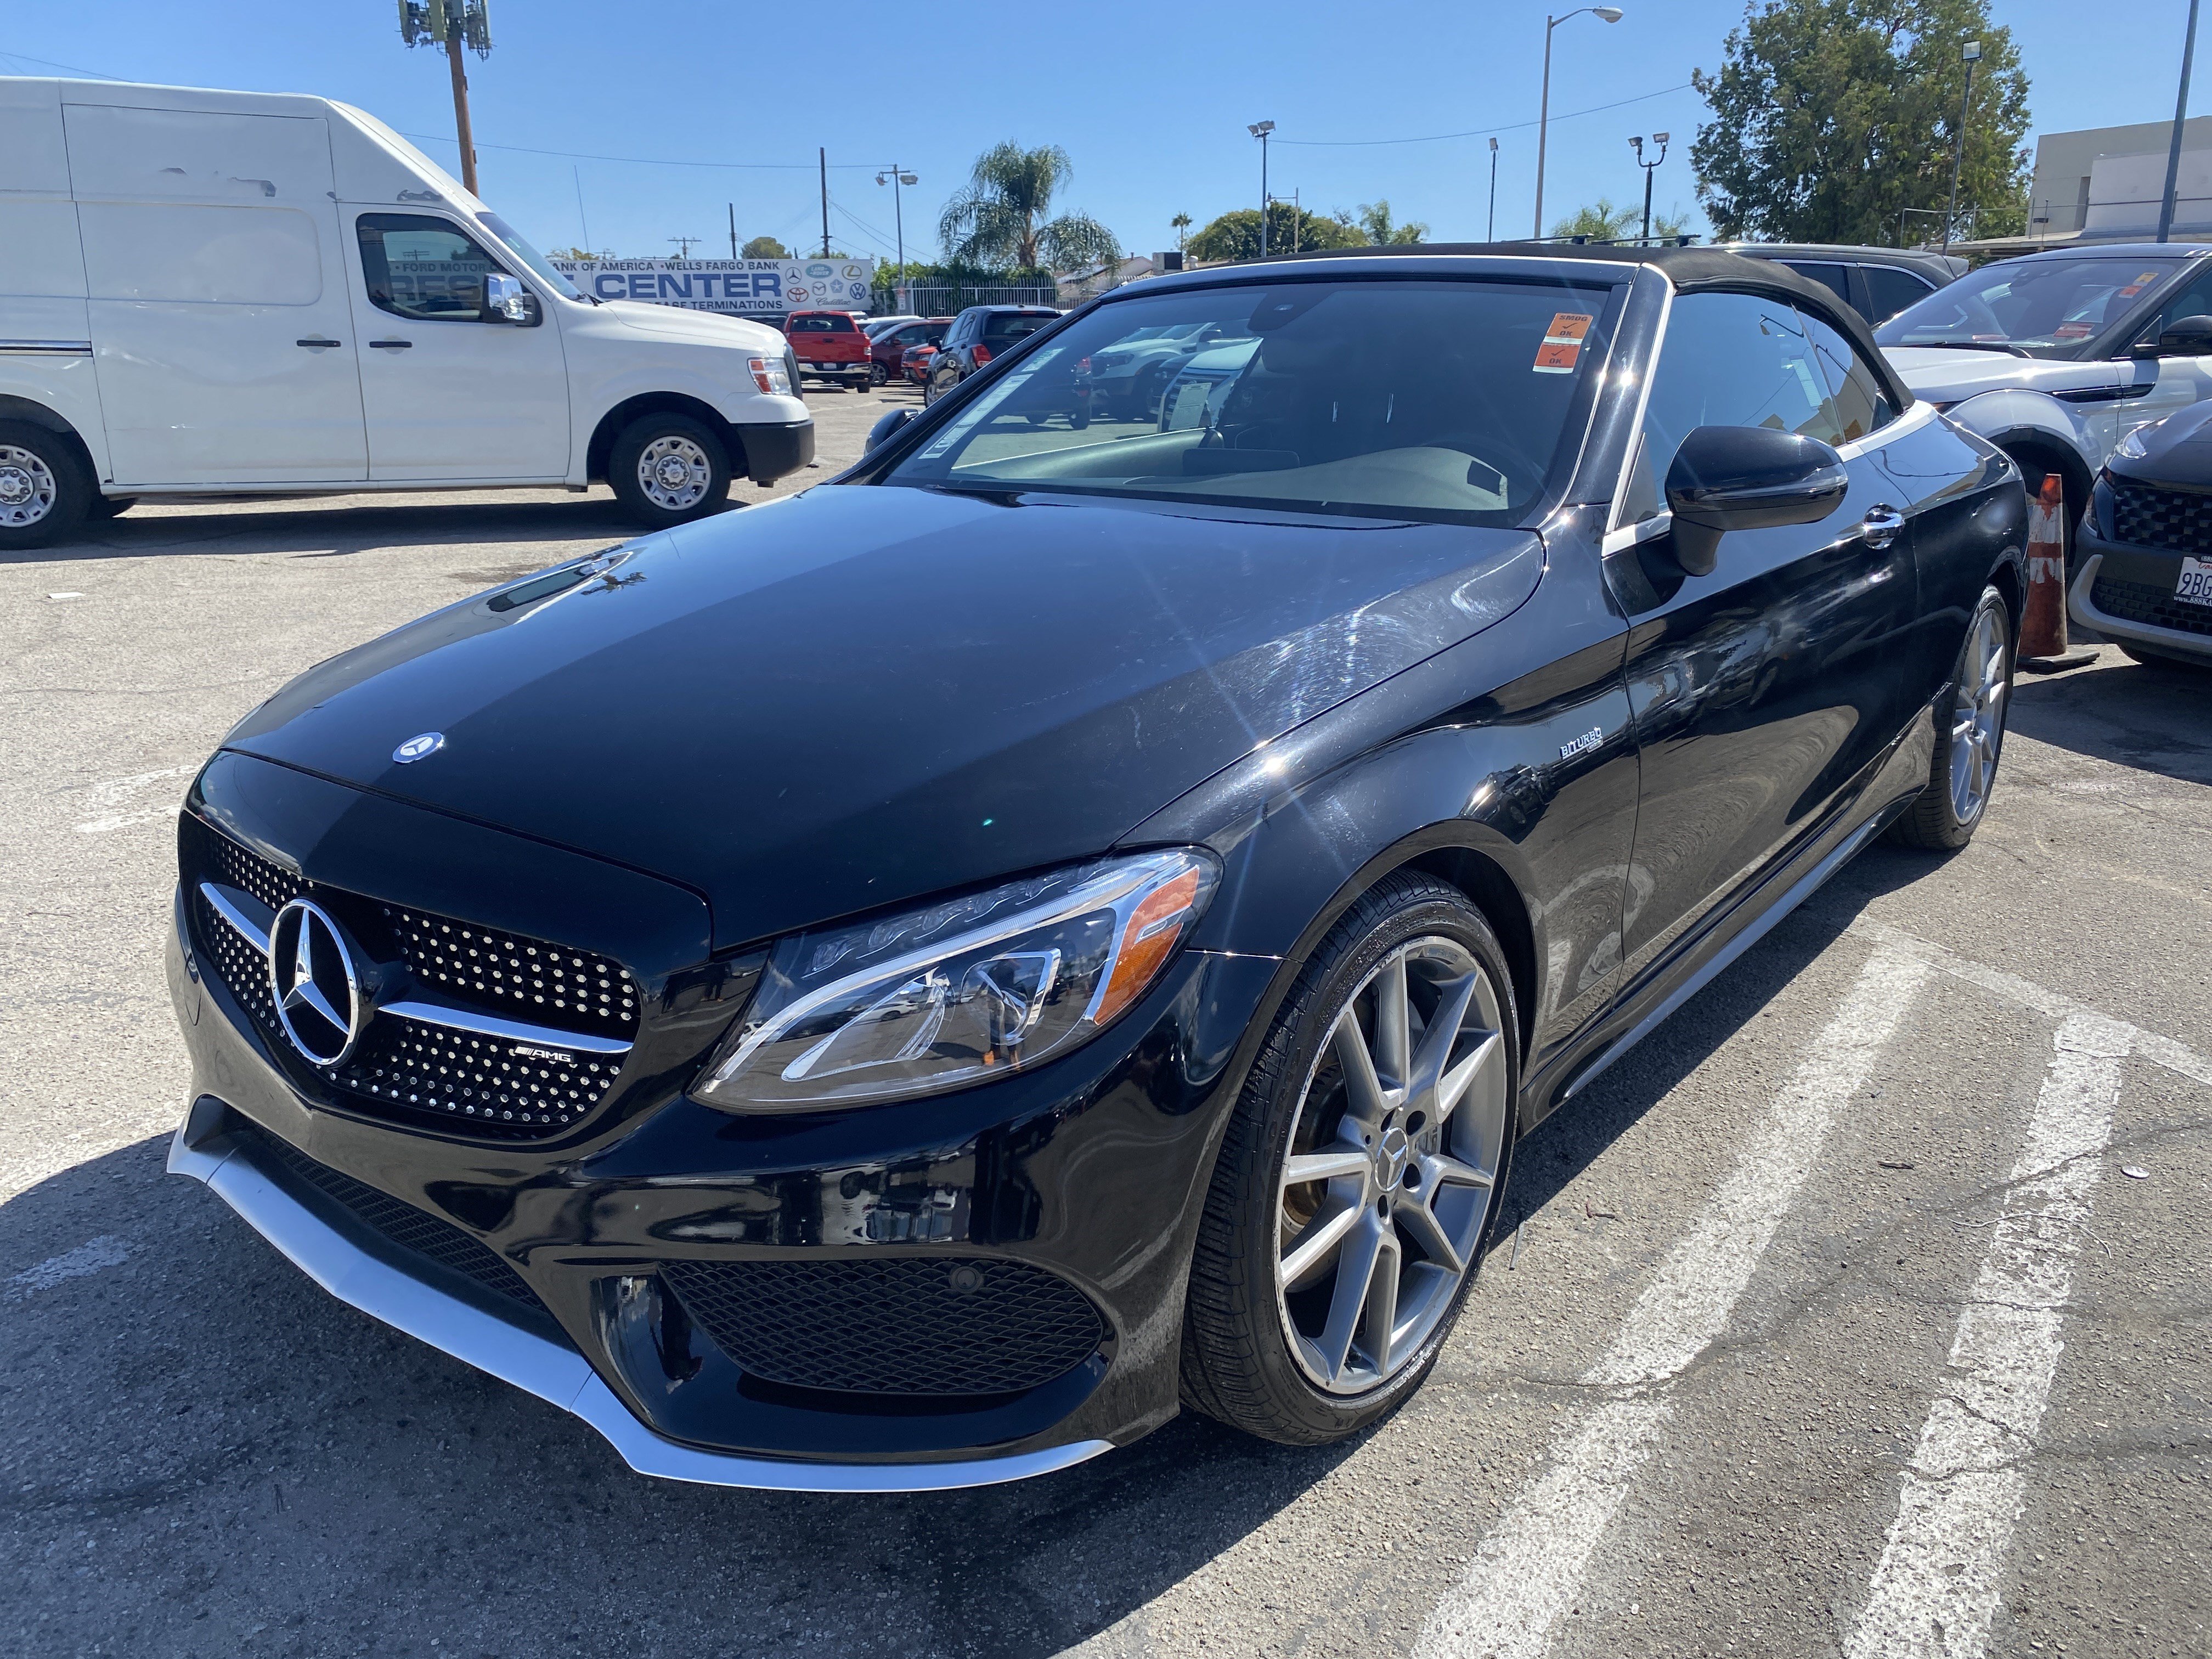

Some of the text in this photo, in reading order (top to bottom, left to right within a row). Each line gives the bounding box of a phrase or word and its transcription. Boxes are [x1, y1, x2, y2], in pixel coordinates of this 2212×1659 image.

[403, 263, 436, 272] FORD
[440, 263, 486, 272] MOTOR
[552, 261, 780, 271] ANK OF AMERICA WELLS FARGO BANK
[595, 273, 782, 298] CENTER
[690, 300, 783, 309] TERMINATIONS
[816, 297, 851, 306] Cadillac
[1560, 726, 1602, 757] BITURBO
